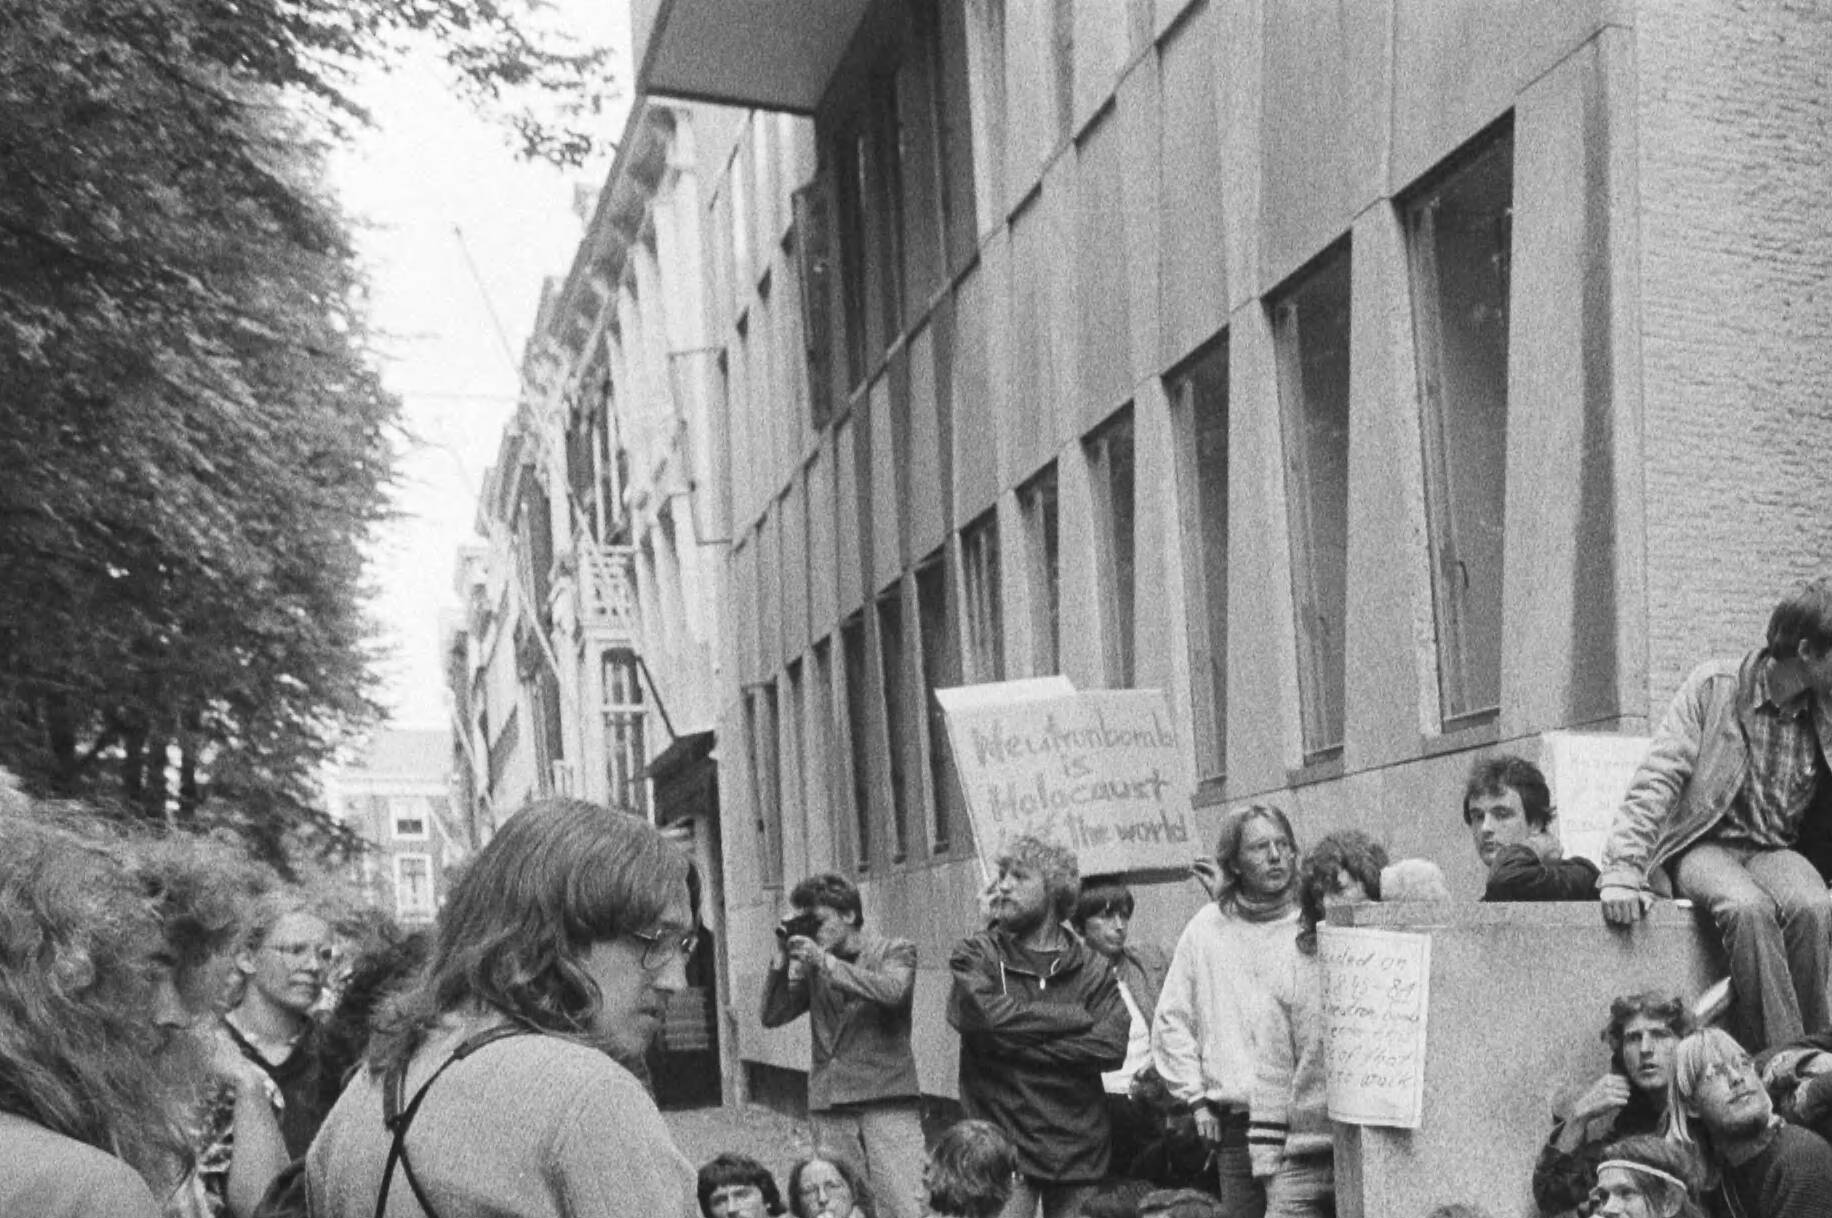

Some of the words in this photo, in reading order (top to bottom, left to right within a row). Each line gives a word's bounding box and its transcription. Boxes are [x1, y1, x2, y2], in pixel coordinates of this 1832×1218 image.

[1060, 752, 1094, 778] is
[987, 769, 1169, 821] Holocaust
[1115, 809, 1188, 844] world
